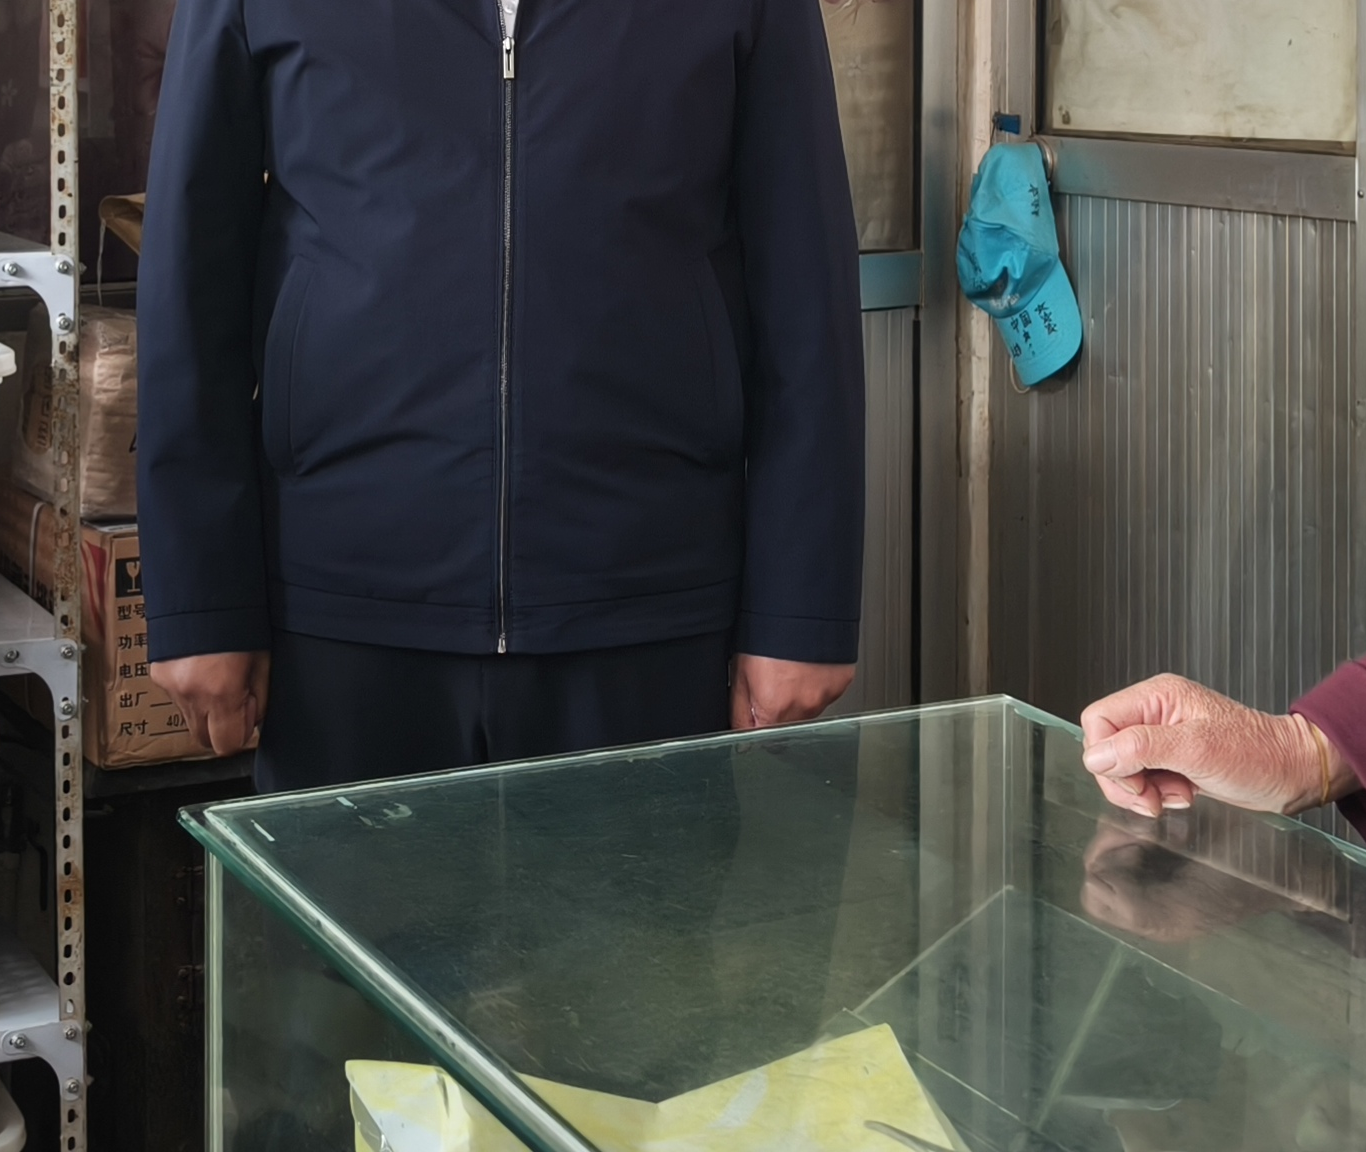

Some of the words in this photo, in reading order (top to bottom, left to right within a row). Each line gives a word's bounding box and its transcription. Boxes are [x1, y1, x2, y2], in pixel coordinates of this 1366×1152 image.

[117, 603, 146, 621] 型号
[118, 632, 148, 649] 功率
[119, 661, 149, 679] 电压
[119, 690, 149, 708] 出厂
[119, 719, 149, 736] 尺寸
